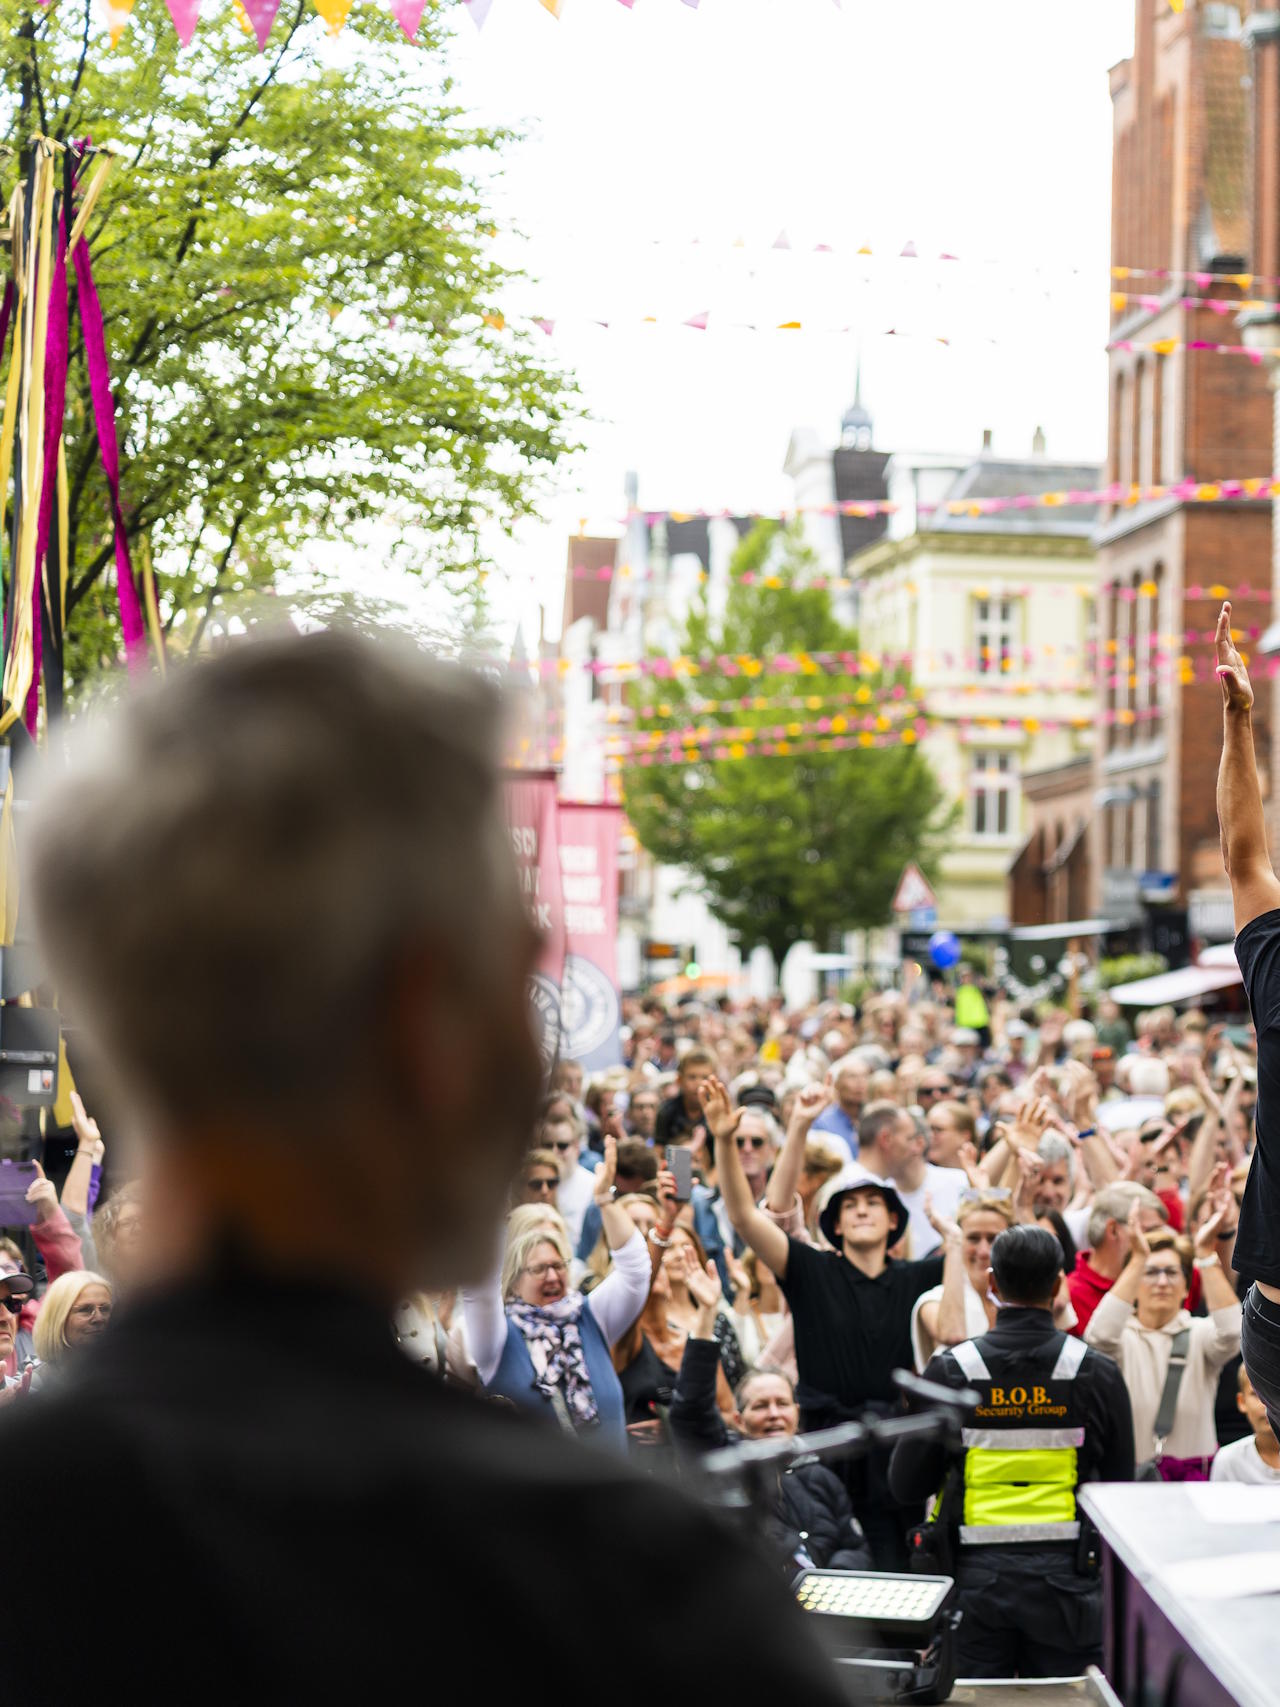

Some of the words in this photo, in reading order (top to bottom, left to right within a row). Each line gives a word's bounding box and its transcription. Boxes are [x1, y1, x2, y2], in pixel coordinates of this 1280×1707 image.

[991, 1386, 1052, 1405] B.O.B.
[975, 1405, 1023, 1418] Security
[1027, 1404, 1067, 1417] Group
